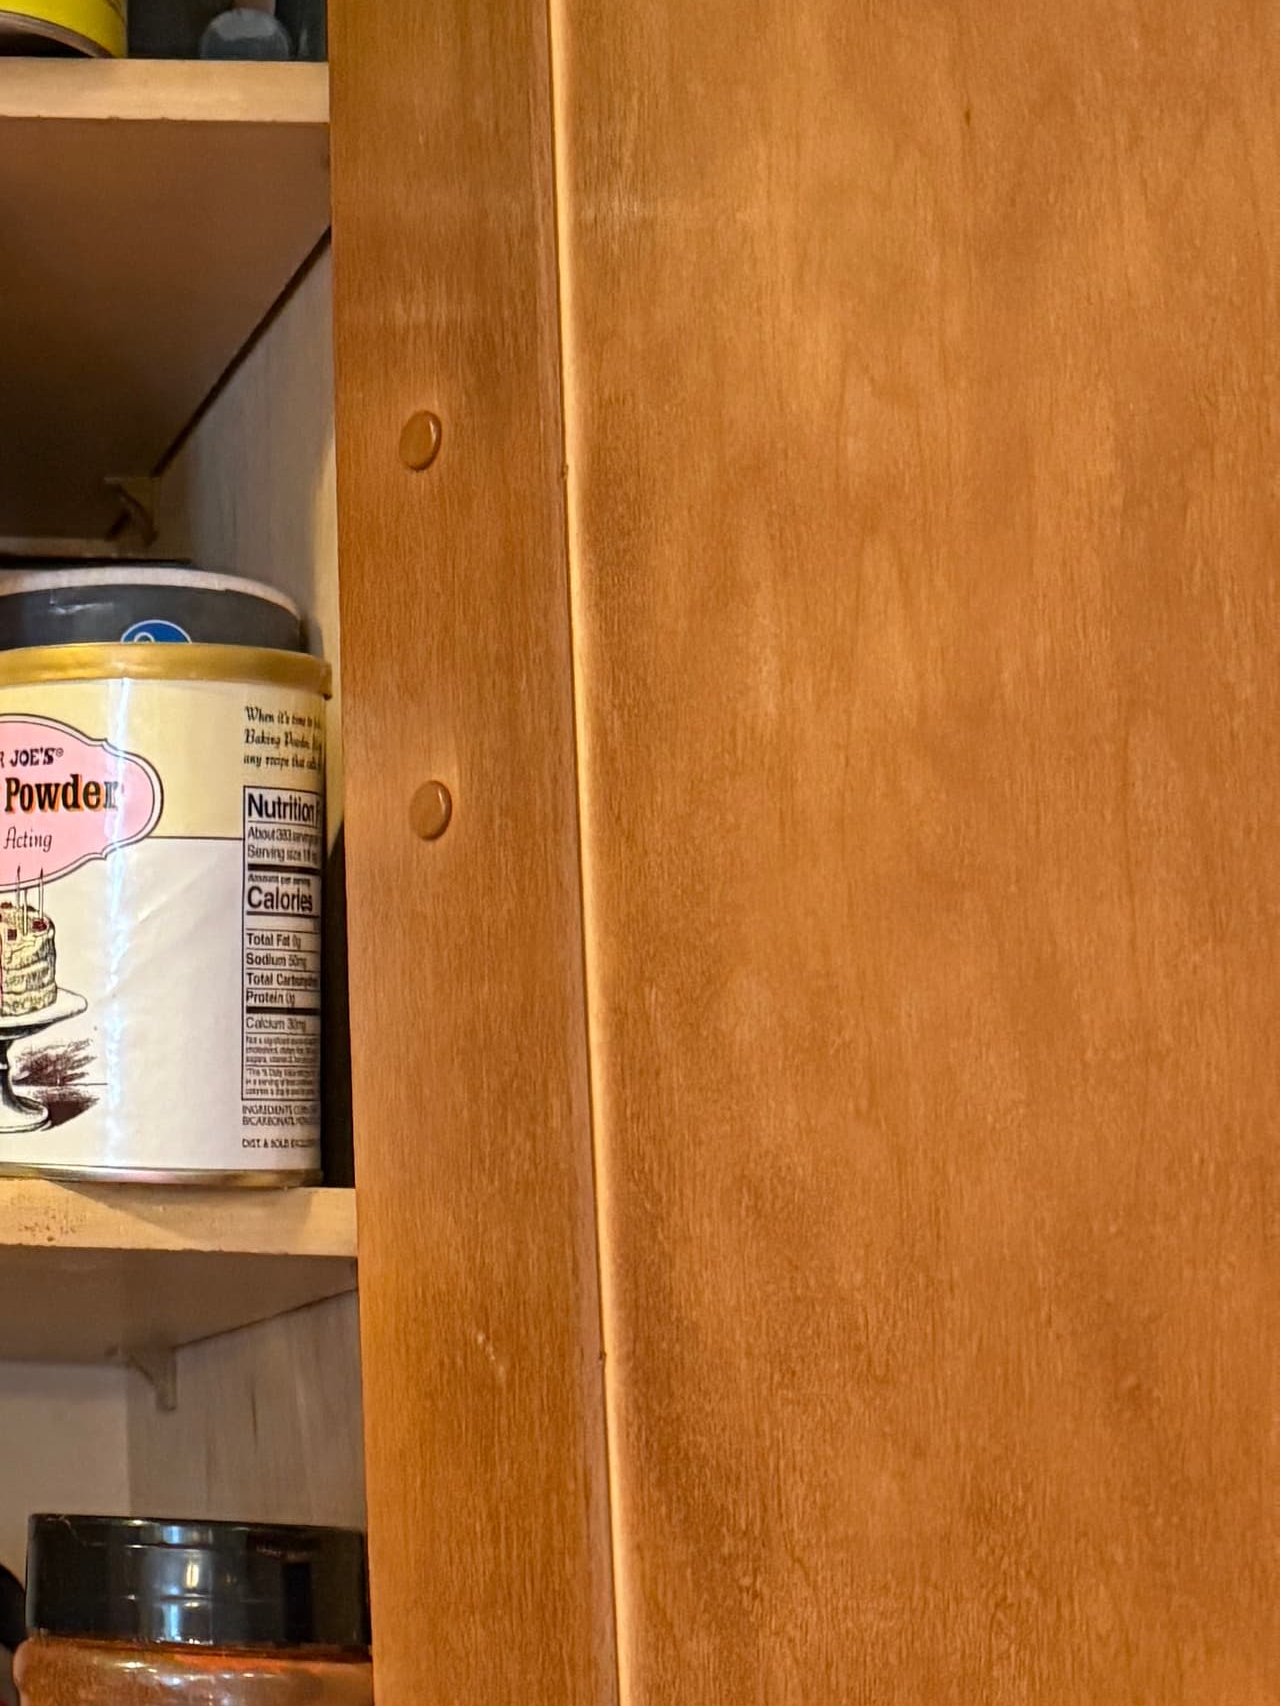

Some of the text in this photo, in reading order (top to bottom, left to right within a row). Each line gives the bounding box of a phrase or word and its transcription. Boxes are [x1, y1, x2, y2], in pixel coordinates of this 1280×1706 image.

[10, 747, 55, 767] JOE'S
[5, 773, 118, 813] Powder
[248, 793, 315, 824] Nutrition
[3, 826, 53, 853] Acting
[247, 886, 313, 912] Calories
